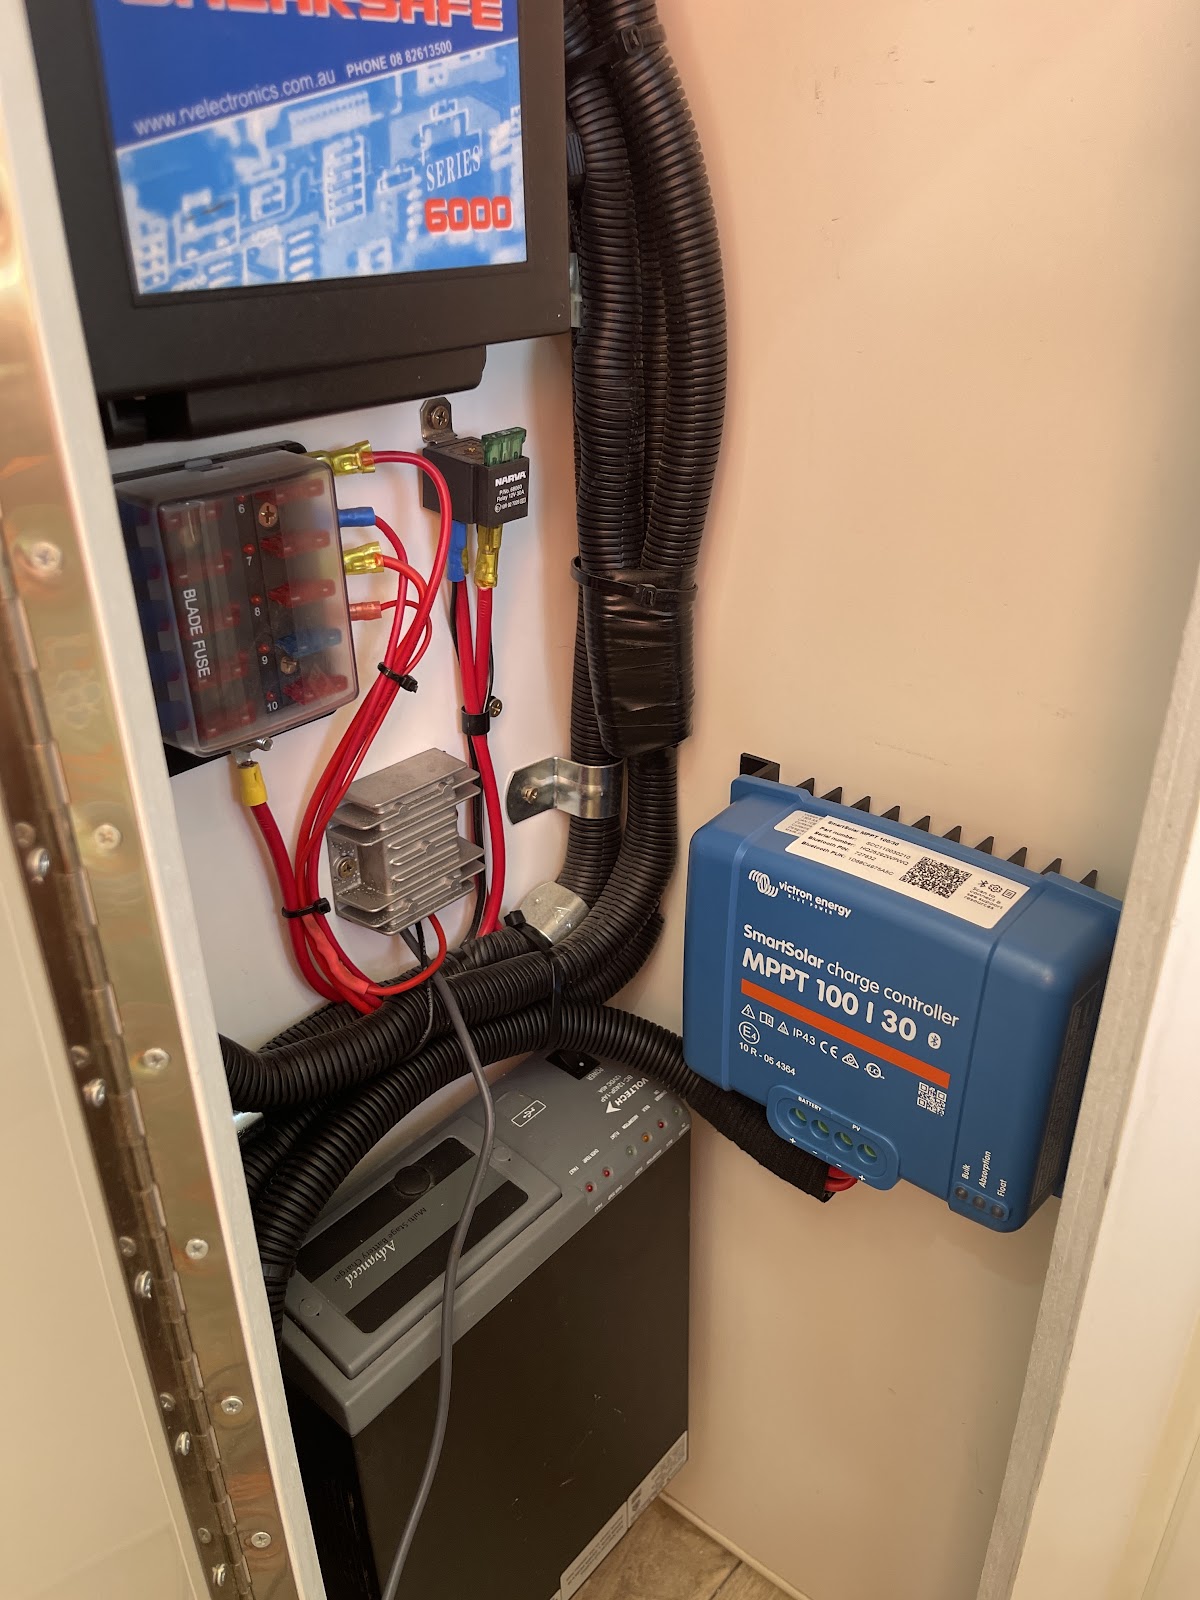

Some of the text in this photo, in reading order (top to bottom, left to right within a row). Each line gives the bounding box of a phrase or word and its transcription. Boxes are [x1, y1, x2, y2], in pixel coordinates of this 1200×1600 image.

[133, 40, 453, 136] www.rvelectronics.com.au PHONE 08 82613500
[426, 145, 481, 192] SERIES
[424, 195, 514, 235] 6000
[495, 471, 527, 487] NARVA
[238, 503, 245, 514] 6
[246, 555, 252, 566] 7
[254, 606, 261, 617] 8
[183, 588, 211, 678] BLADE FUSE
[261, 655, 268, 665] 9
[267, 701, 278, 712] 10
[779, 881, 852, 919] victron energy
[743, 923, 960, 1027] SmartSolar charge controller
[742, 947, 810, 993] MPPT
[816, 978, 859, 1016] 100
[881, 1009, 917, 1042] 30
[792, 1027, 816, 1046] IP43
[739, 1042, 749, 1052] 10
[750, 1047, 758, 1056] R
[764, 1054, 774, 1065] 05
[775, 1060, 796, 1076] 4364
[614, 1077, 649, 1106] VOLTECH
[798, 1095, 822, 1112] BATTERY
[852, 1123, 861, 1132] PV
[961, 1163, 971, 1180] Bulk
[978, 1150, 992, 1189] Absorption
[996, 1178, 1008, 1198] Float
[332, 1206, 427, 1282] Multi-Stage Battery Charger
[344, 1239, 396, 1289] Advanced
